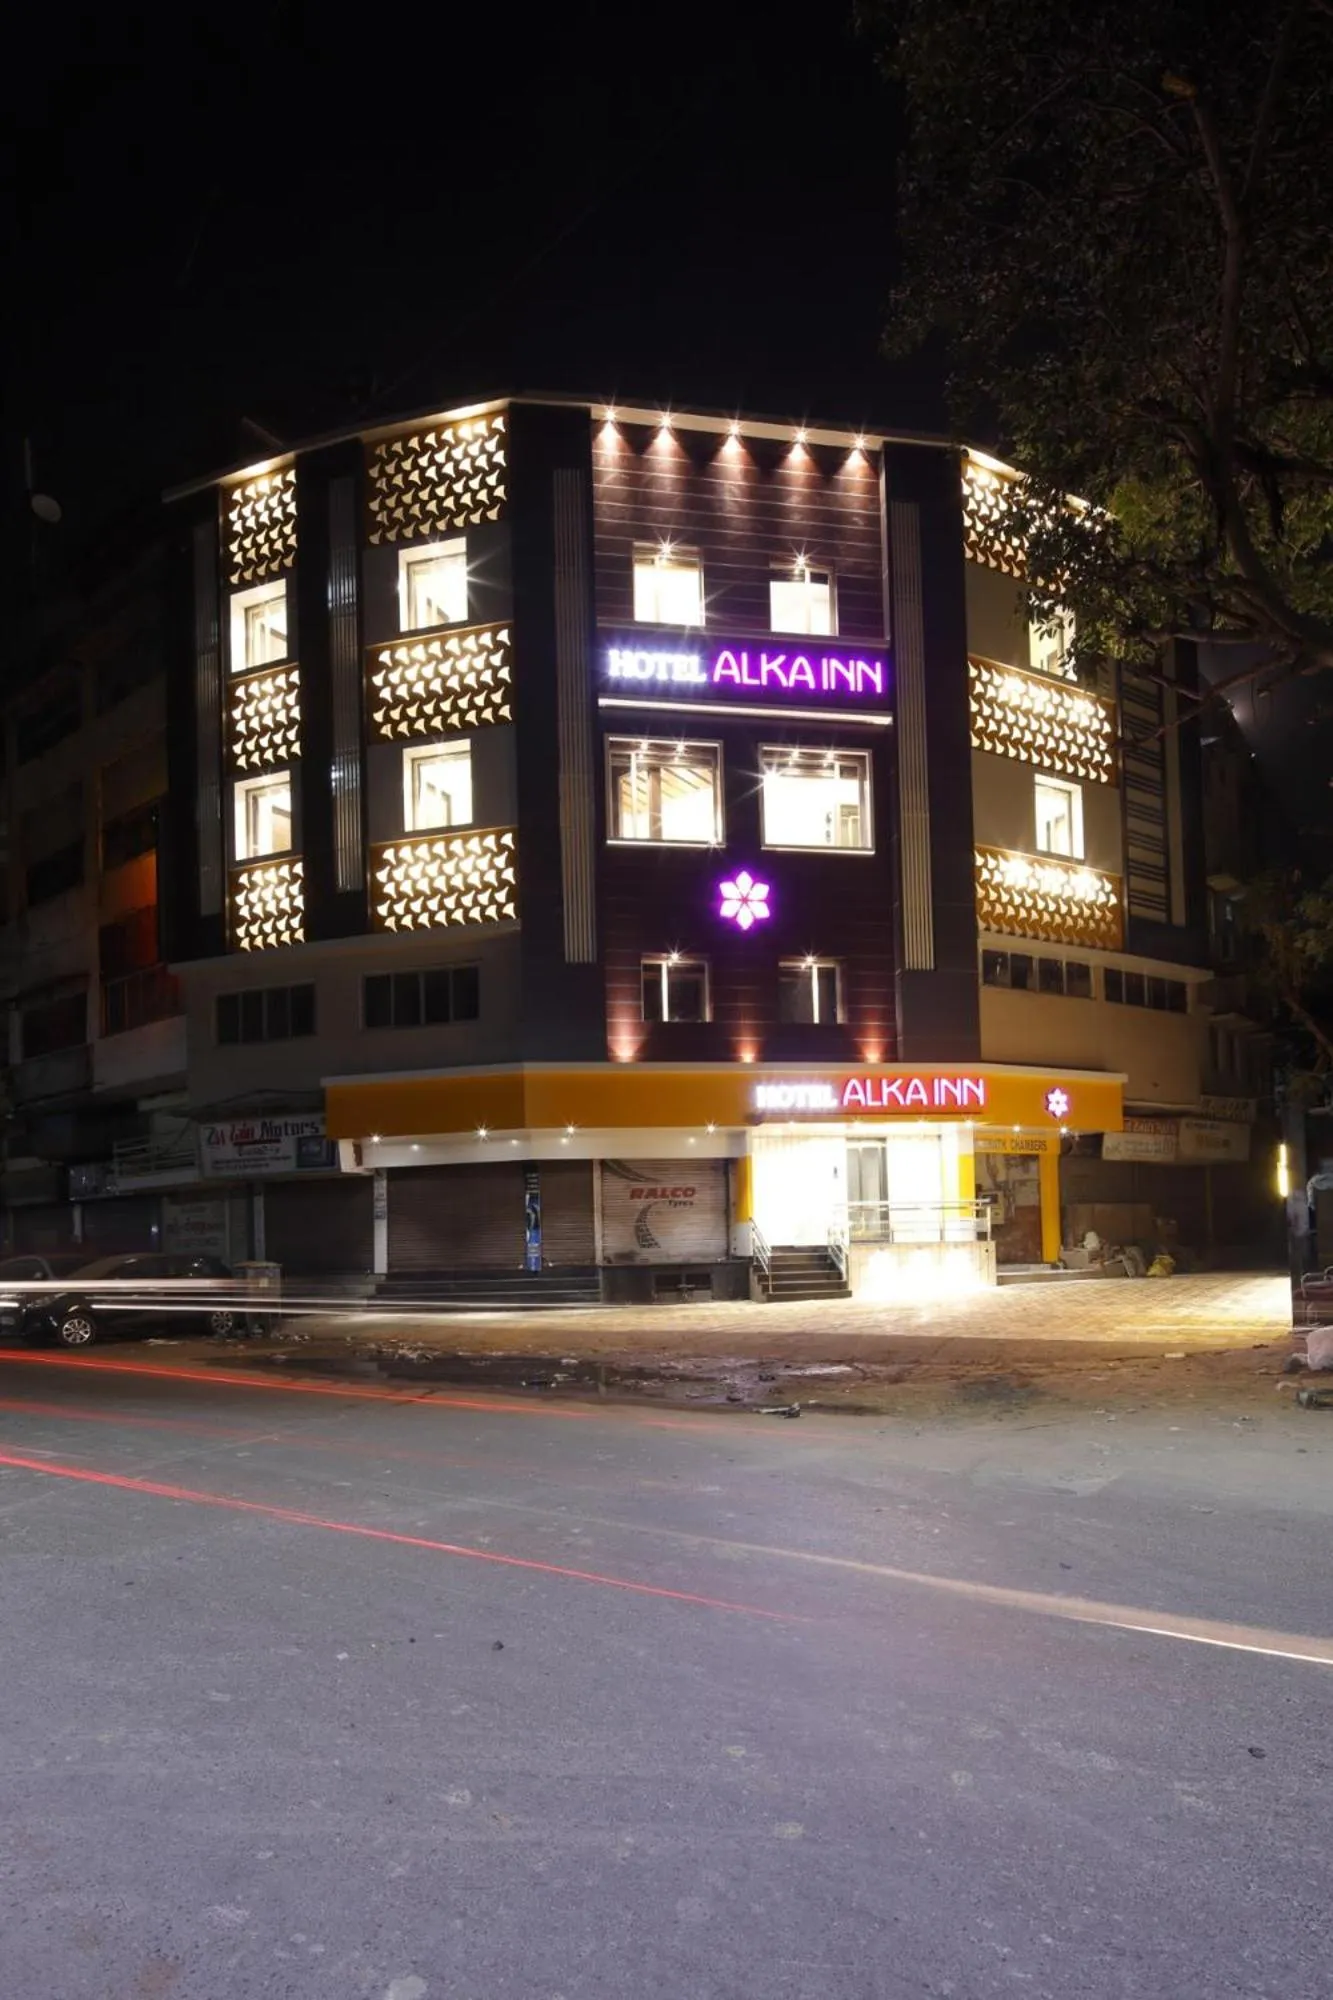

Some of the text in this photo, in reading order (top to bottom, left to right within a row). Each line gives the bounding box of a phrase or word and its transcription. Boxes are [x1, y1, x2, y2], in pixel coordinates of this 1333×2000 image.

[608, 648, 884, 694] HOTEL ALKA INN
[755, 1077, 986, 1109] HOTEL ALKA INN
[629, 1187, 696, 1200] RALCO
